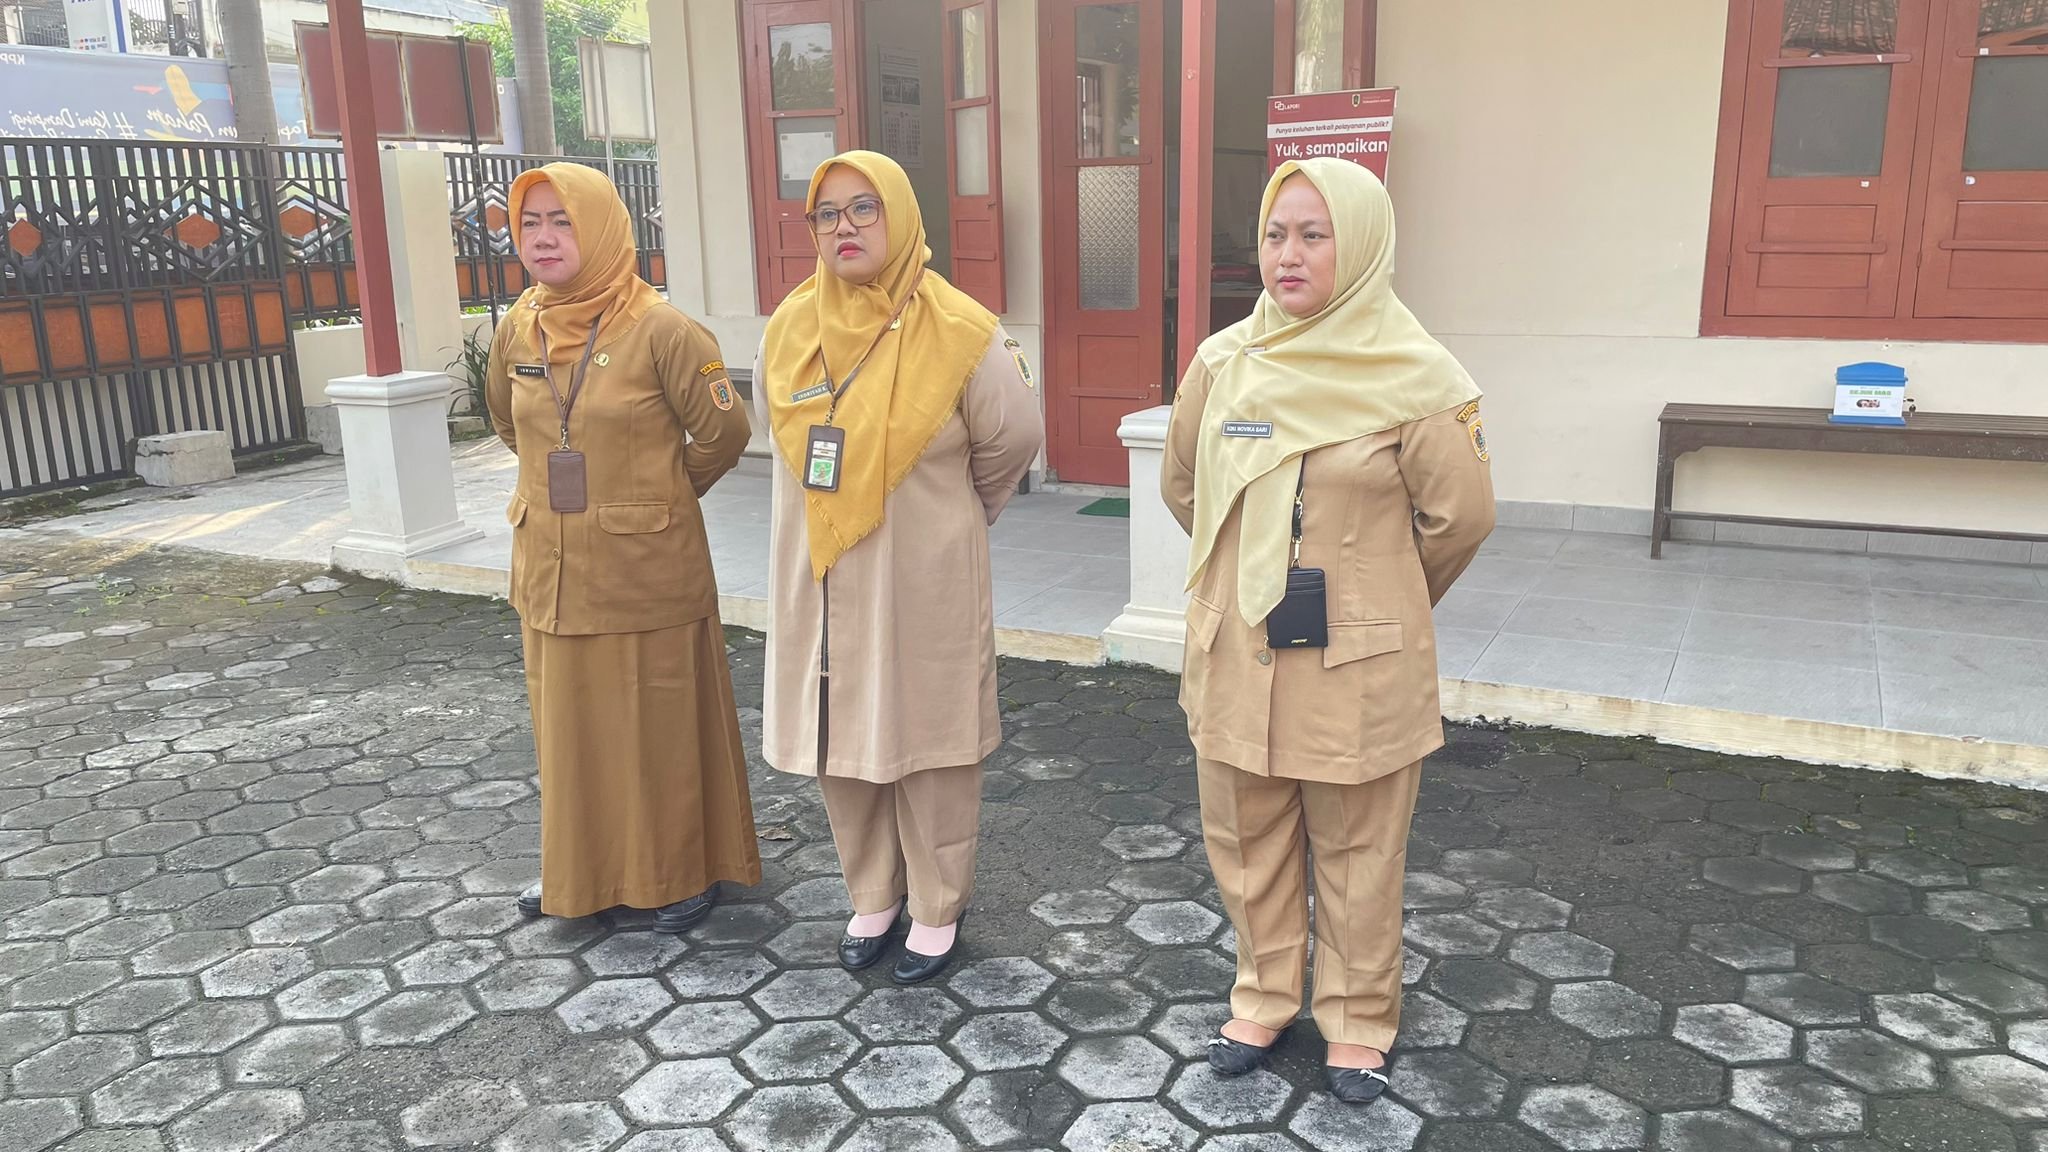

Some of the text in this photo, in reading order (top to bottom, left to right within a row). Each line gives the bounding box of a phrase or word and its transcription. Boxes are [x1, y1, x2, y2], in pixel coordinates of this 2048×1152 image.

[1275, 127, 1292, 135] Punya
[1292, 125, 1315, 133] keluhan
[1334, 122, 1366, 132] pelayanan
[1366, 120, 1390, 130] publik?
[1274, 137, 1388, 158] Yuk, sampaikan
